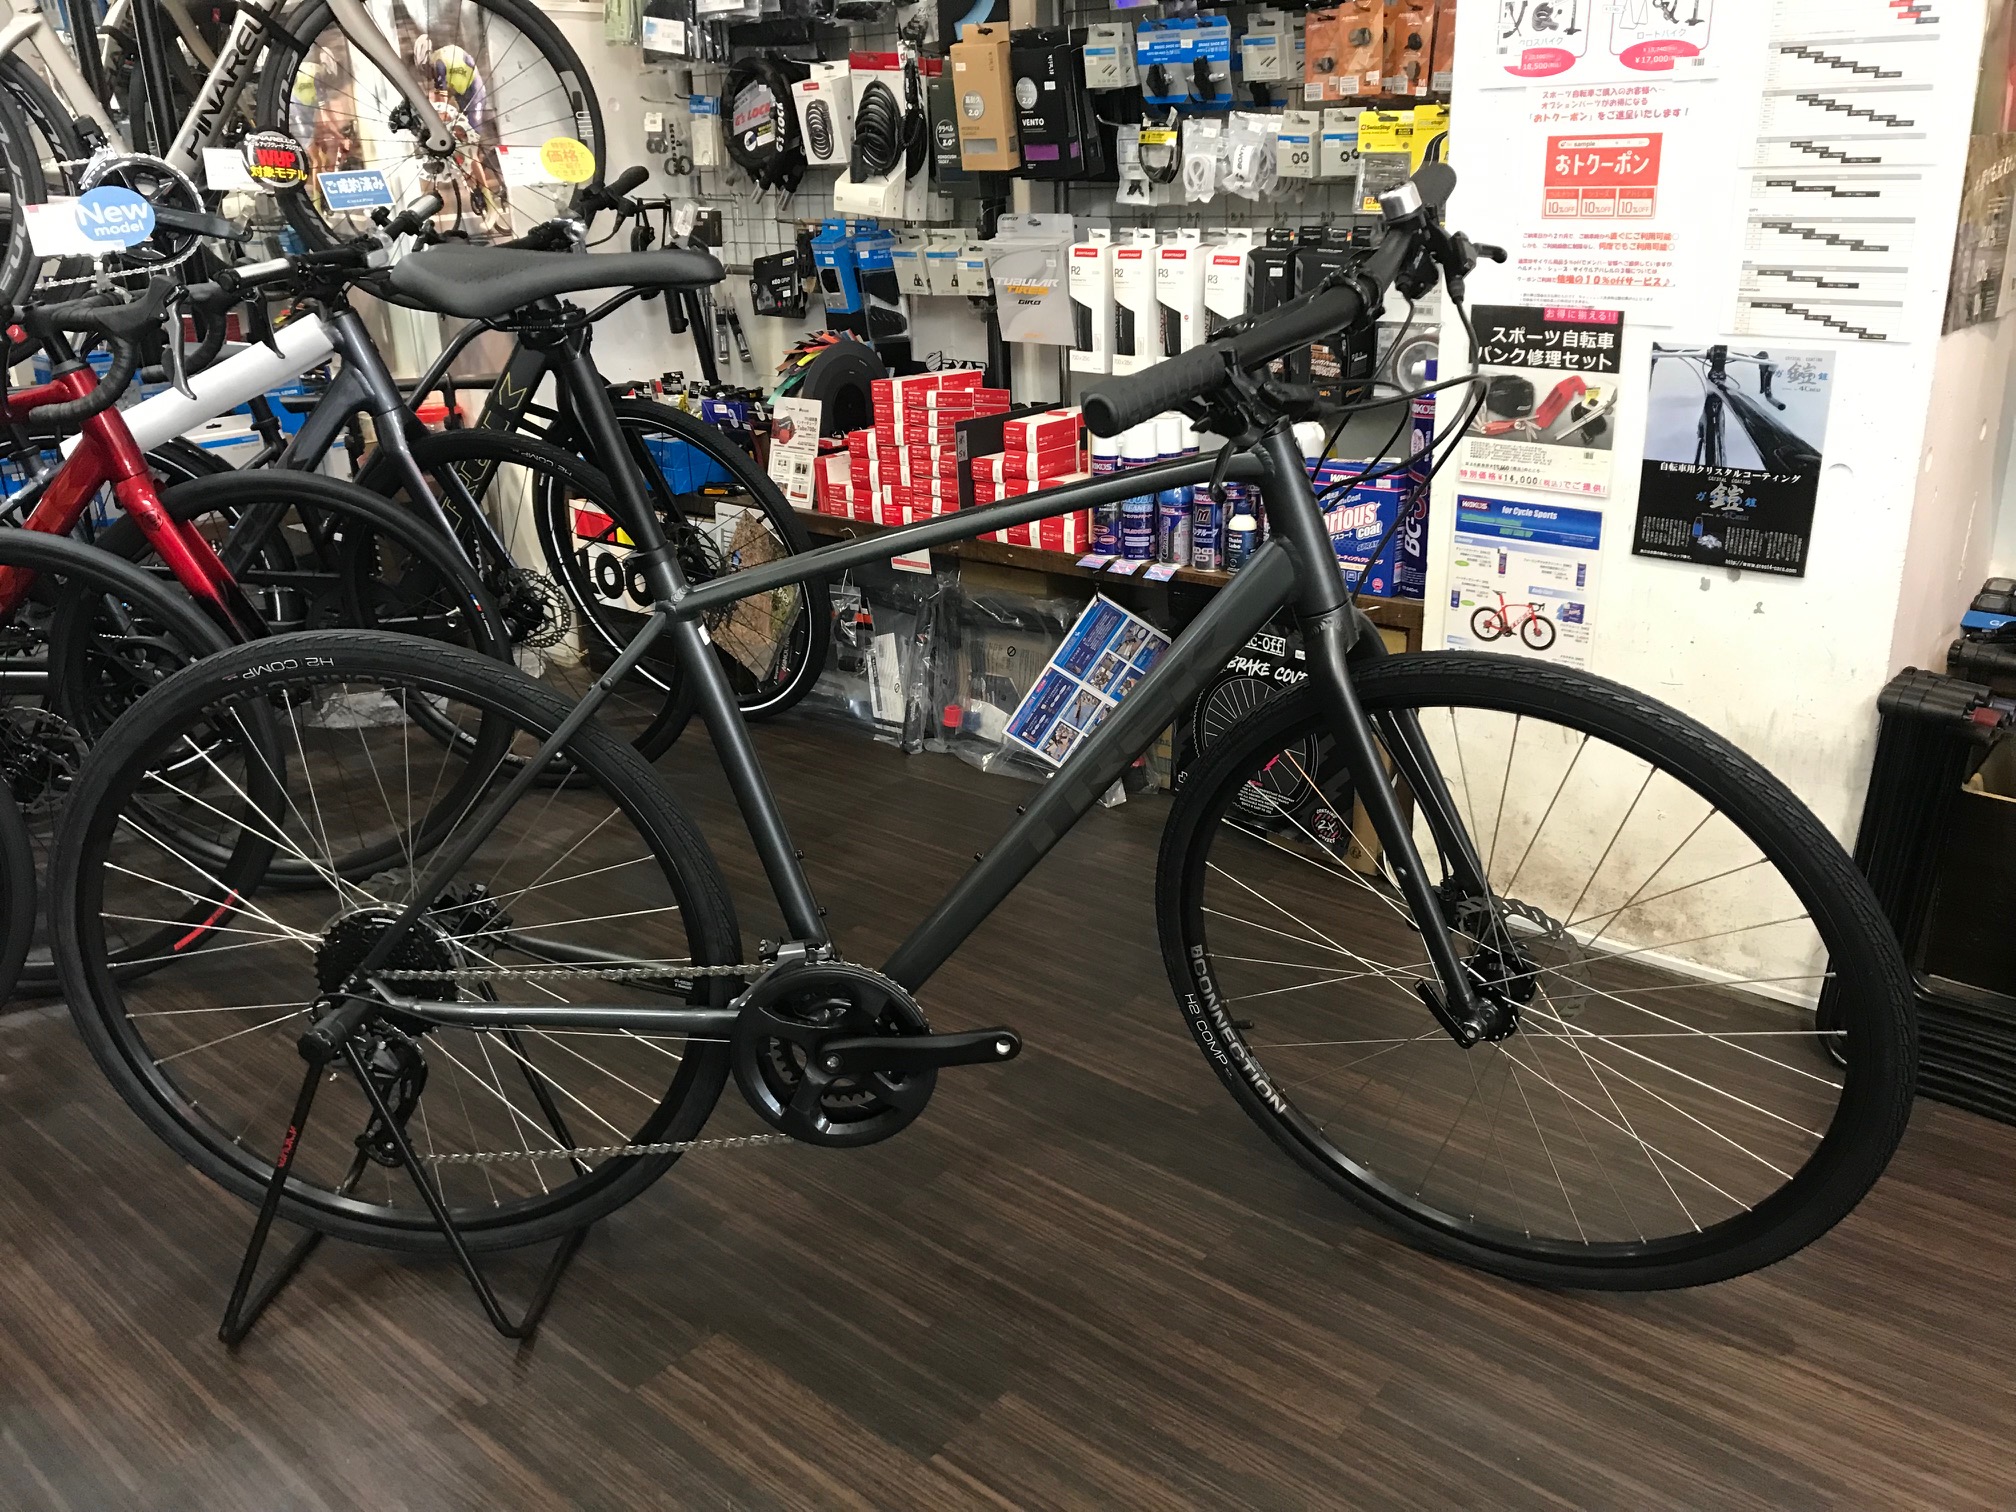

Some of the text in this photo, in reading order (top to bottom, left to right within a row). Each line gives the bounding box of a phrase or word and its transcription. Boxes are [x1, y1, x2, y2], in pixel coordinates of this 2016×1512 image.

[1022, 118, 1044, 126] VENTO
[256, 149, 296, 168] WUP
[1555, 151, 1650, 176] おトクーポン
[251, 166, 308, 180] 対象モデル
[325, 176, 385, 194] ご成約済み
[76, 202, 149, 226] New
[94, 220, 145, 237] model
[1071, 266, 1081, 275] R2
[1114, 268, 1124, 278] R2
[1158, 269, 1169, 278] R3
[994, 277, 1059, 287] TUBULAR
[1207, 275, 1218, 284] R3
[1007, 286, 1049, 295] TIRES
[1490, 326, 1615, 349] スポーツ自転車
[1478, 346, 1612, 370] パンク修理セット
[1660, 462, 1802, 485] 自転車用クリスタルコーティング
[1502, 506, 1558, 520] for Cycle Sports
[1357, 522, 1381, 539] coat
[242, 657, 335, 680] H2 COMP
[1227, 655, 1271, 677] BRAKE
[1317, 819, 1336, 834] 2X
[1184, 993, 1228, 1066] H2 COMP
